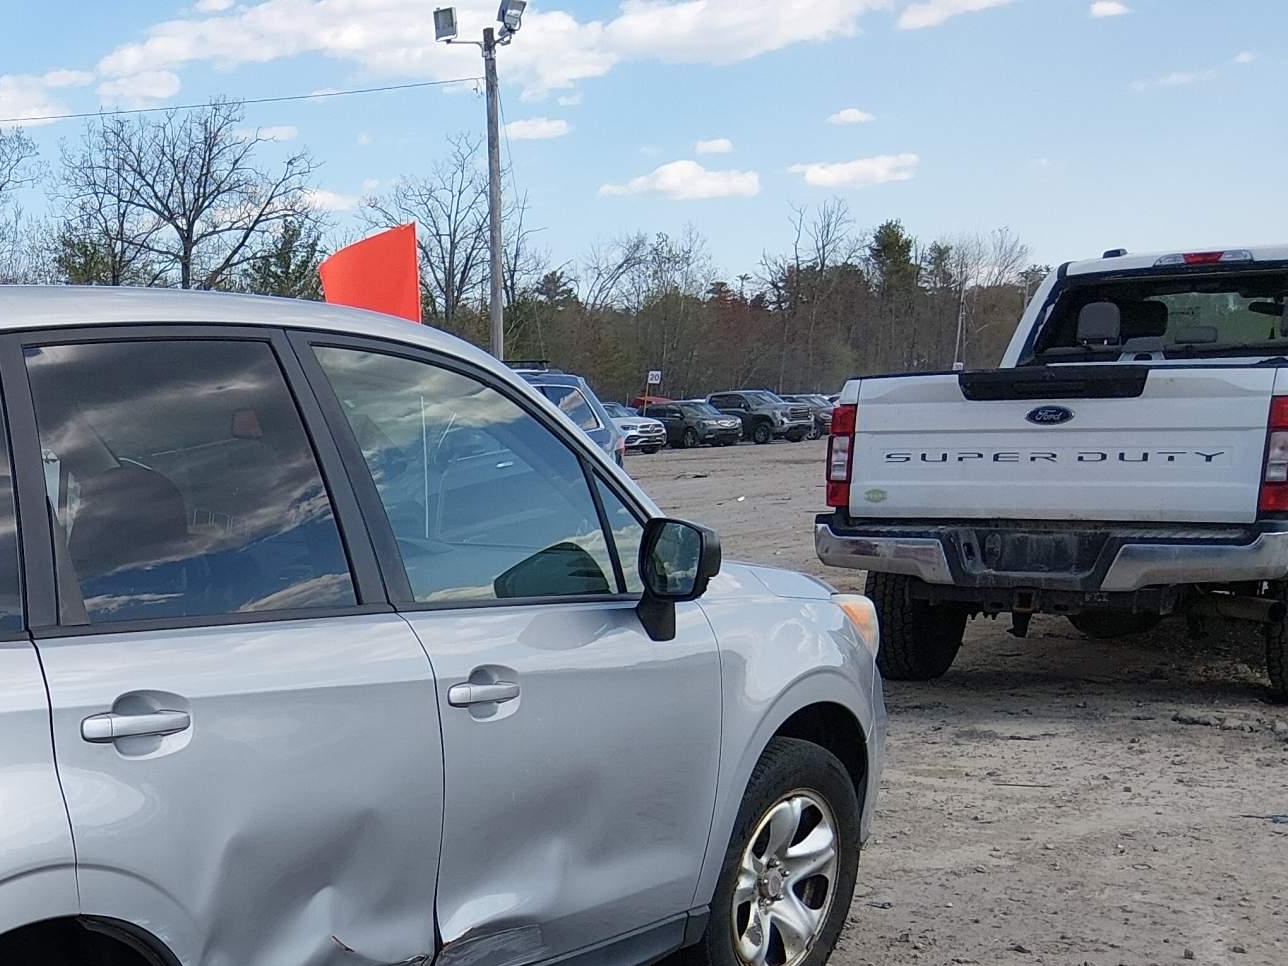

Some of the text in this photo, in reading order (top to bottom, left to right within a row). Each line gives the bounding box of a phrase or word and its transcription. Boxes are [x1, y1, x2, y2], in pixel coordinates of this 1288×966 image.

[649, 373, 660, 381] 20
[1034, 409, 1063, 421] Ford
[885, 451, 1225, 463] SUPER DUTY
